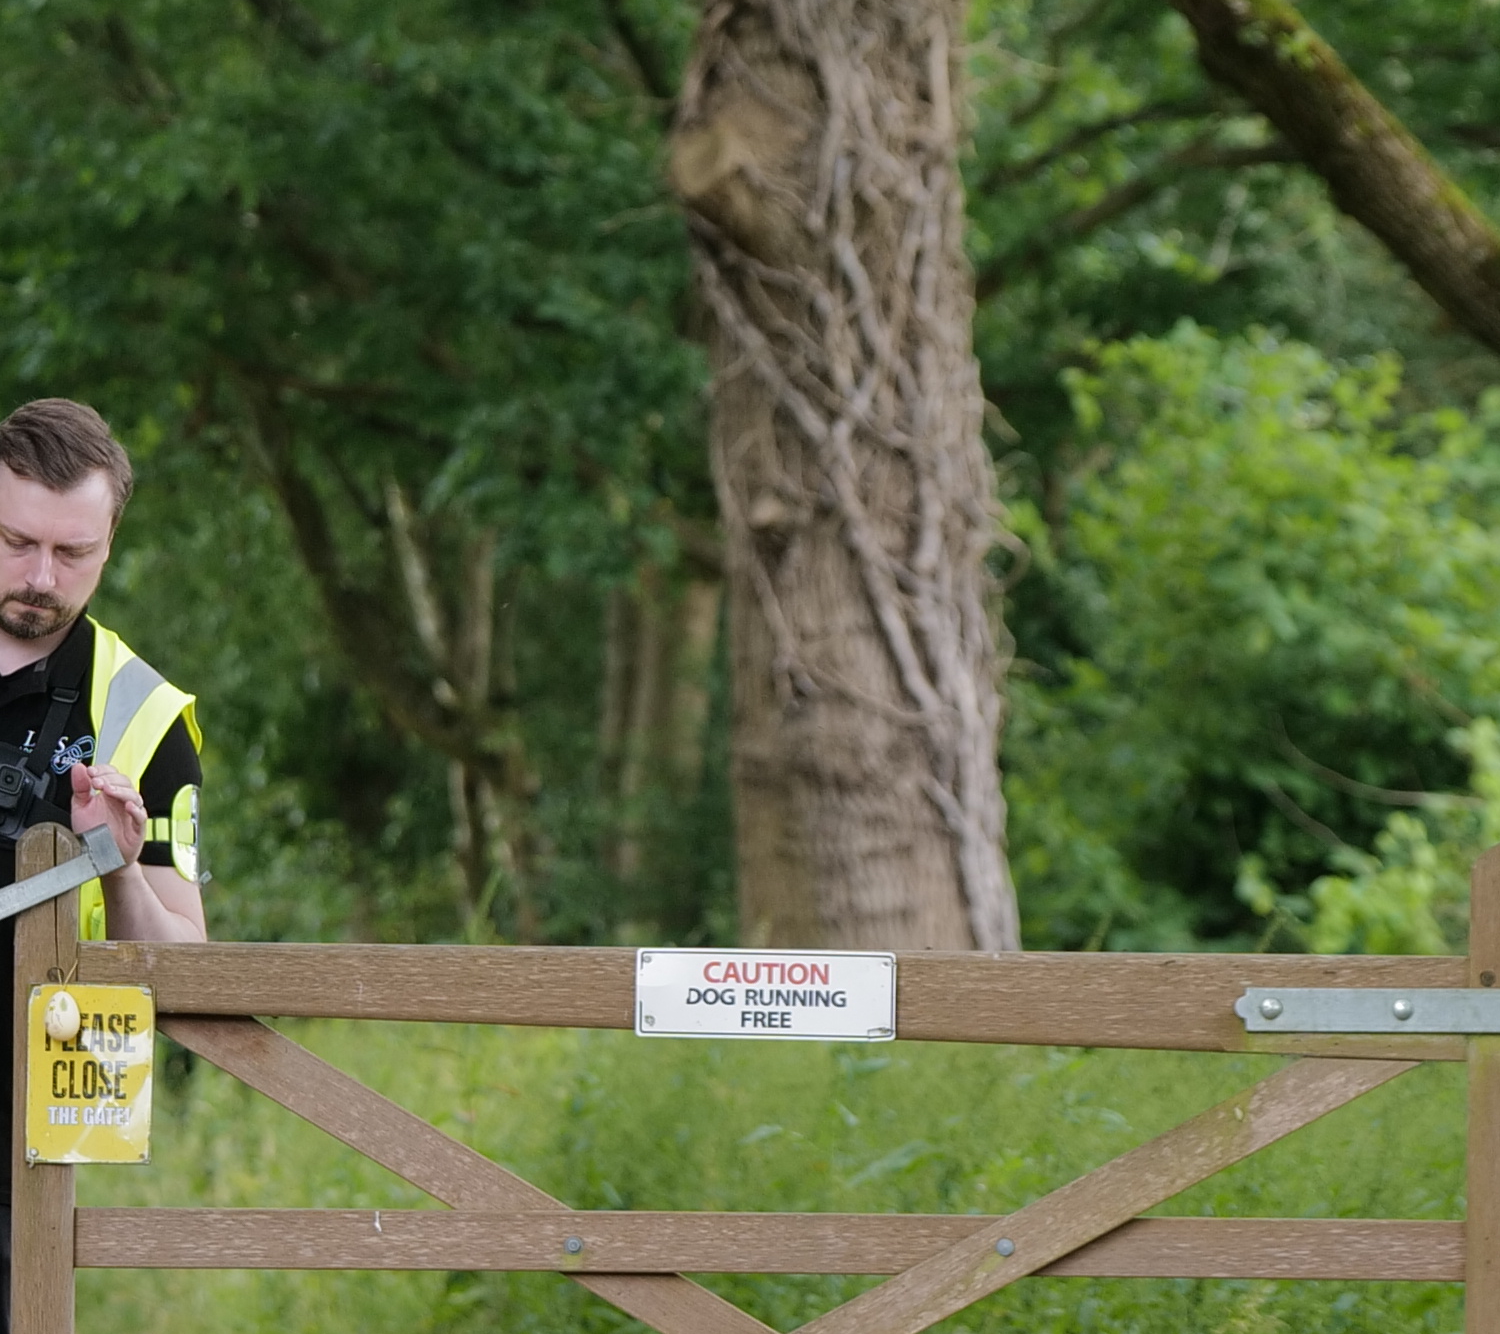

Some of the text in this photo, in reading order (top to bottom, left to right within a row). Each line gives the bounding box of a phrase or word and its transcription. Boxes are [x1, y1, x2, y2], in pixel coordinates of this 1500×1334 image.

[702, 961, 830, 986] CAUTION
[685, 988, 847, 1008] DOG RUNNING
[740, 1011, 792, 1029] FREE
[52, 1059, 128, 1100] CLOSE
[47, 1105, 131, 1126] THE GATE!
